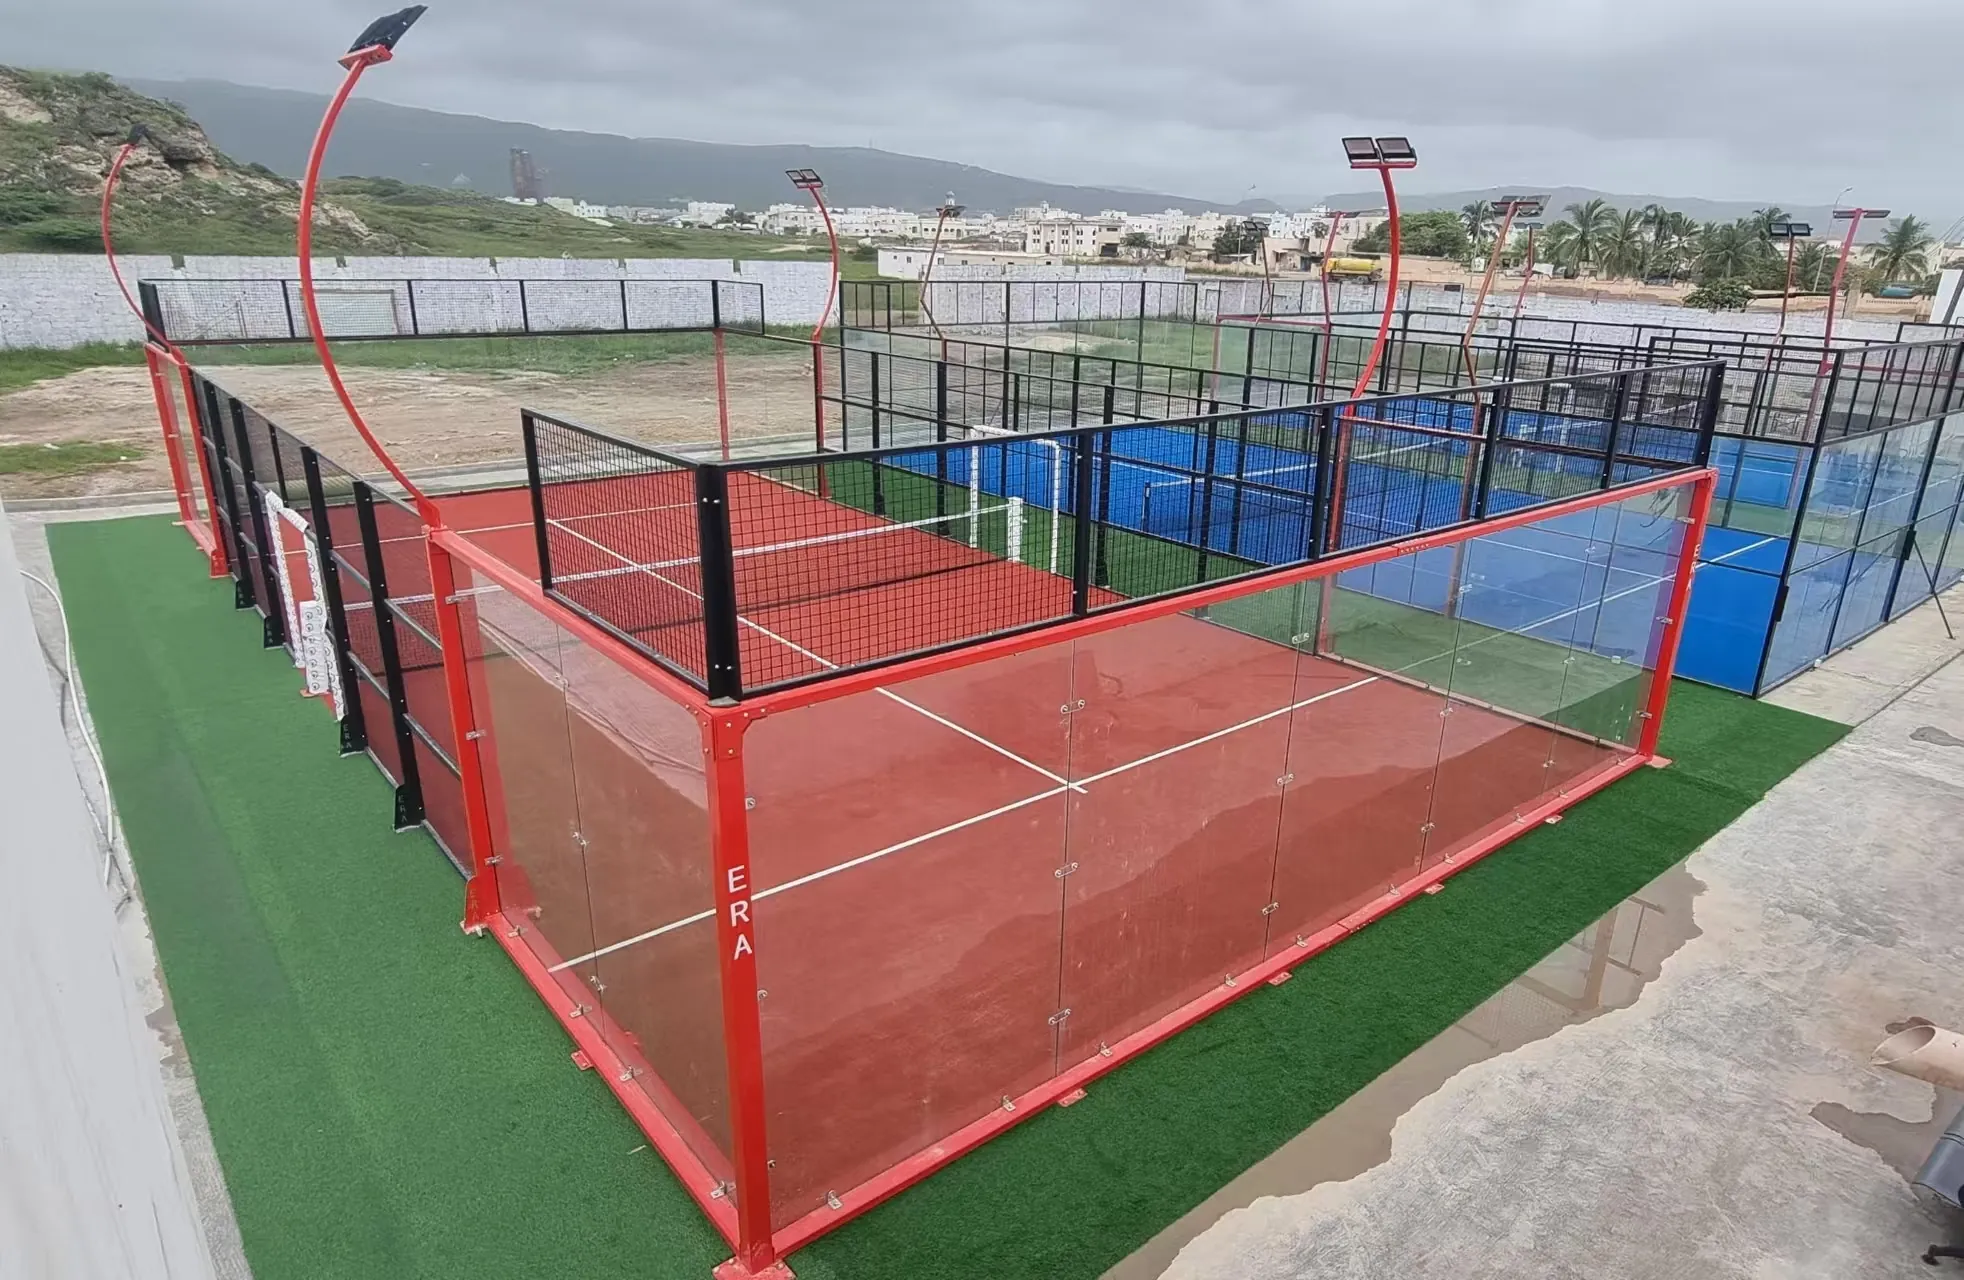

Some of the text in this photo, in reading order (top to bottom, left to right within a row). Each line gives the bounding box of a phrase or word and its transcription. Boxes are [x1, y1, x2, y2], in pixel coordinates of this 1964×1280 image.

[1686, 544, 1700, 591] ERA
[344, 724, 352, 748] ERA
[398, 795, 407, 823] ERA
[470, 888, 479, 921] ERA
[728, 865, 752, 960] ERA
